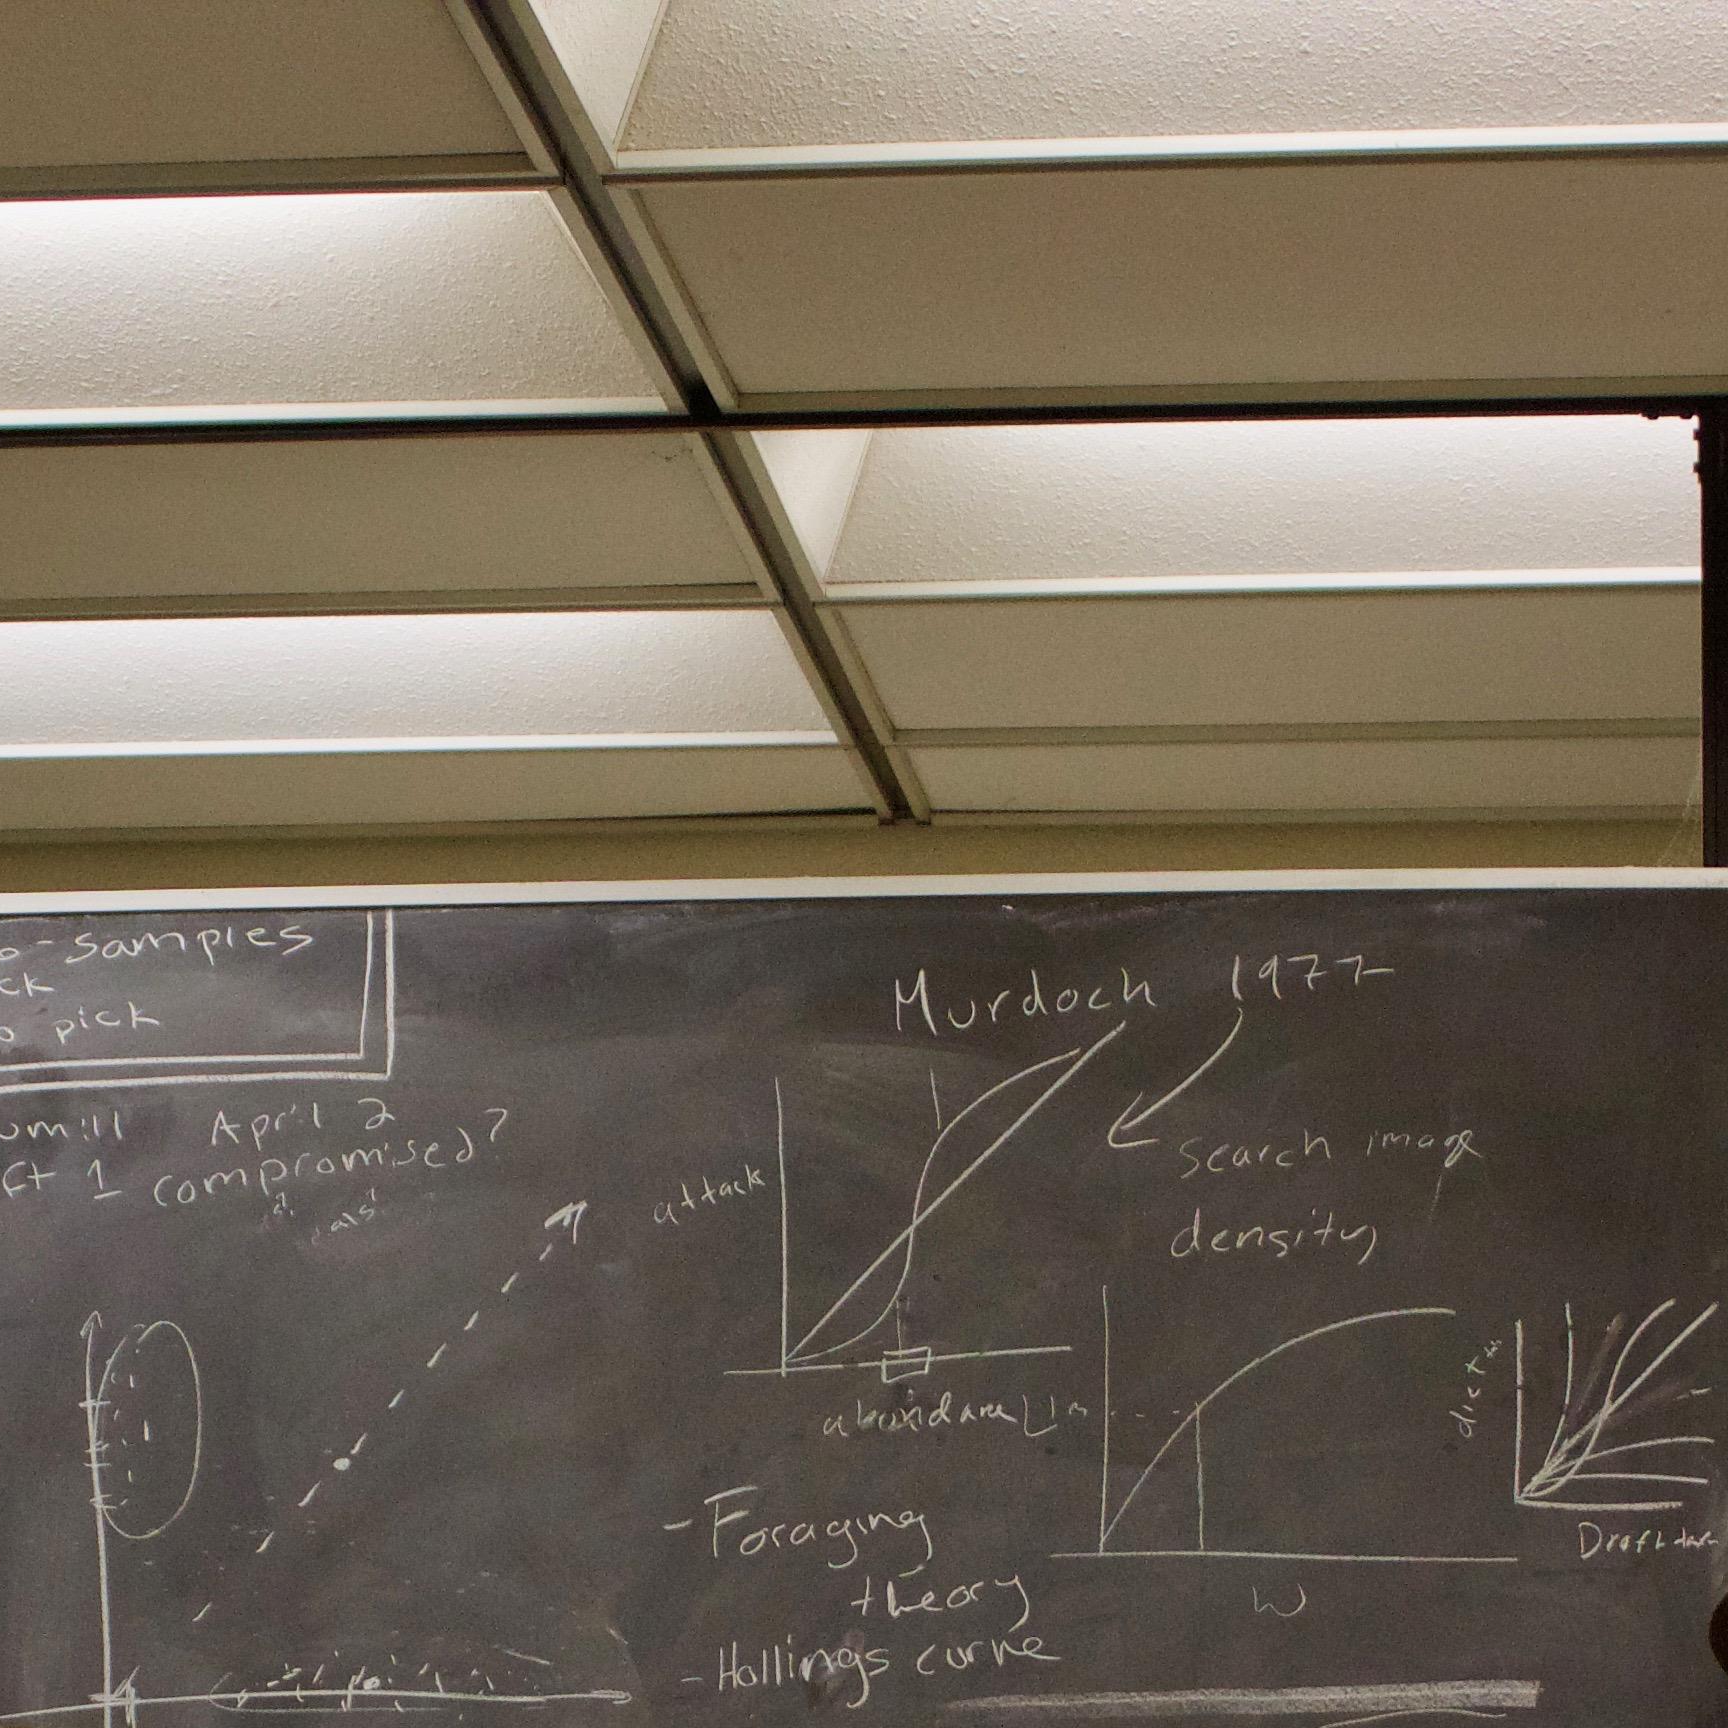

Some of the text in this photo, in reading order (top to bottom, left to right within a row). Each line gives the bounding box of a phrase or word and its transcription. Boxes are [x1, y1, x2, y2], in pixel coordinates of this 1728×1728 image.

[57, 999, 162, 1045] pick
[895, 953, 1395, 1036] Murdoch 1977
[212, 1103, 321, 1152] April
[357, 1098, 396, 1133] 2
[653, 1164, 766, 1226] attack
[1171, 1208, 1378, 1267] density
[704, 1485, 933, 1568] Foraging
[852, 1570, 1031, 1632] theory
[718, 1634, 890, 1709] Hollings
